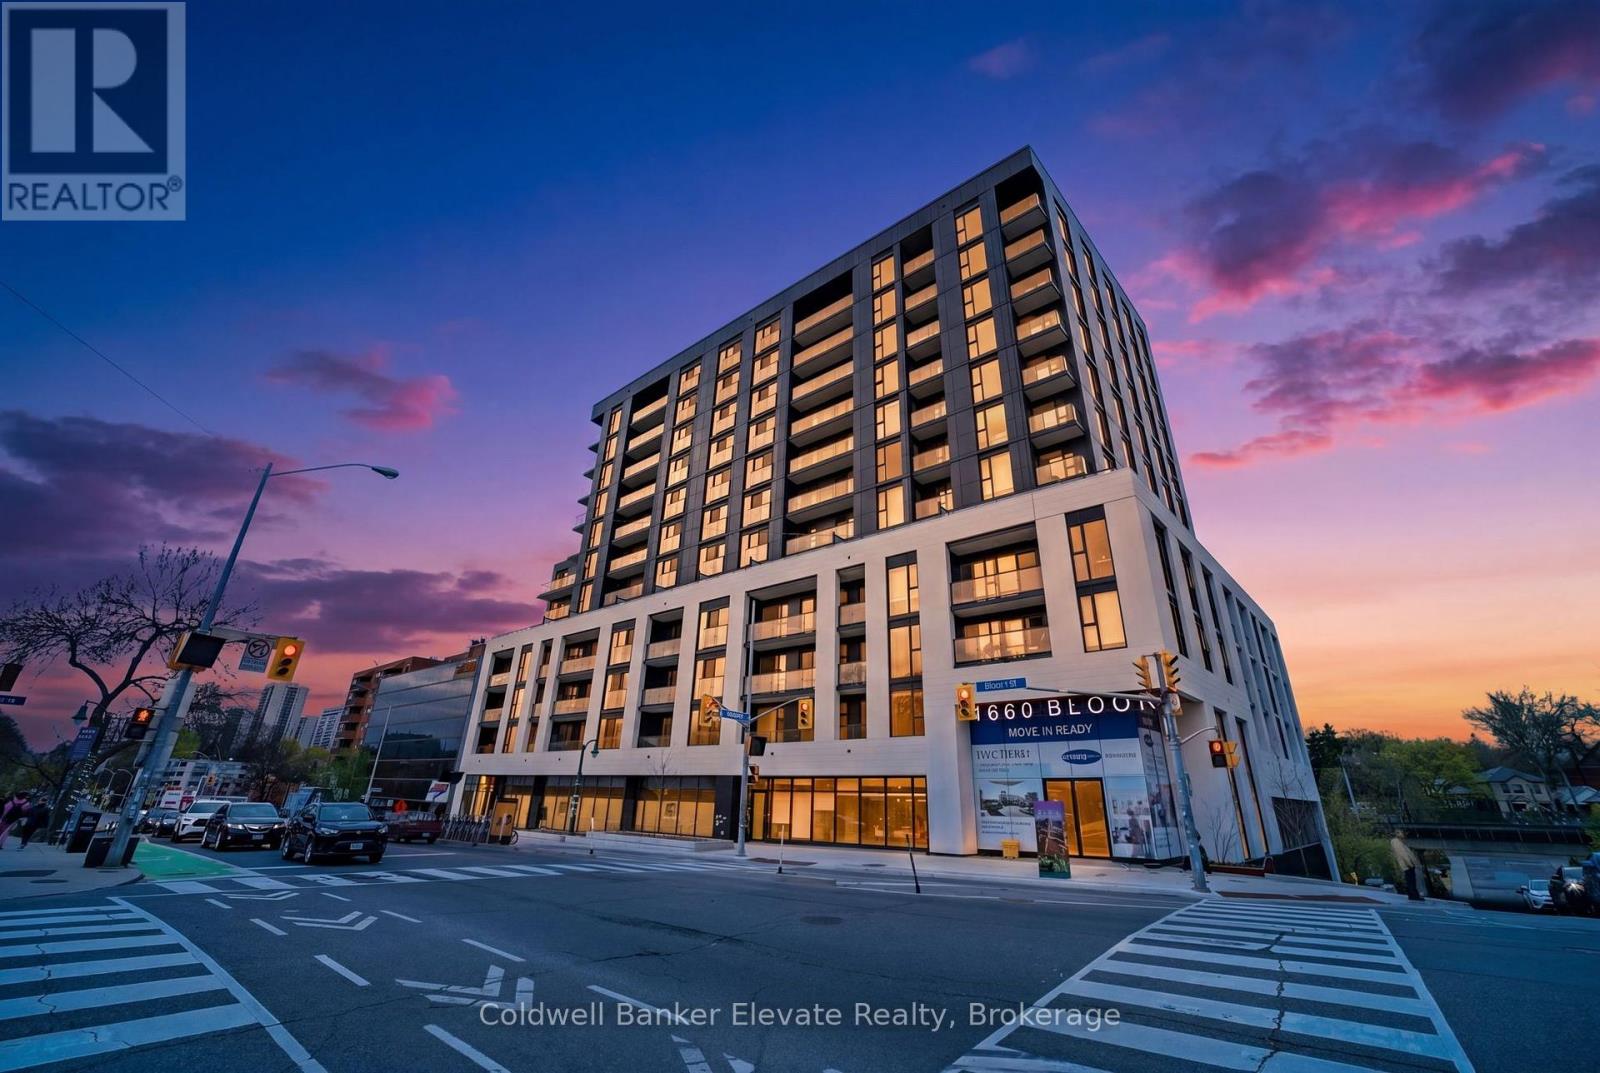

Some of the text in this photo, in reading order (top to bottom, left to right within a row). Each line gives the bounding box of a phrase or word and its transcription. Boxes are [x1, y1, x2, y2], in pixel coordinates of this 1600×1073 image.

[974, 702, 1033, 722] 1660
[1008, 723, 1093, 738] MOVE IN READY
